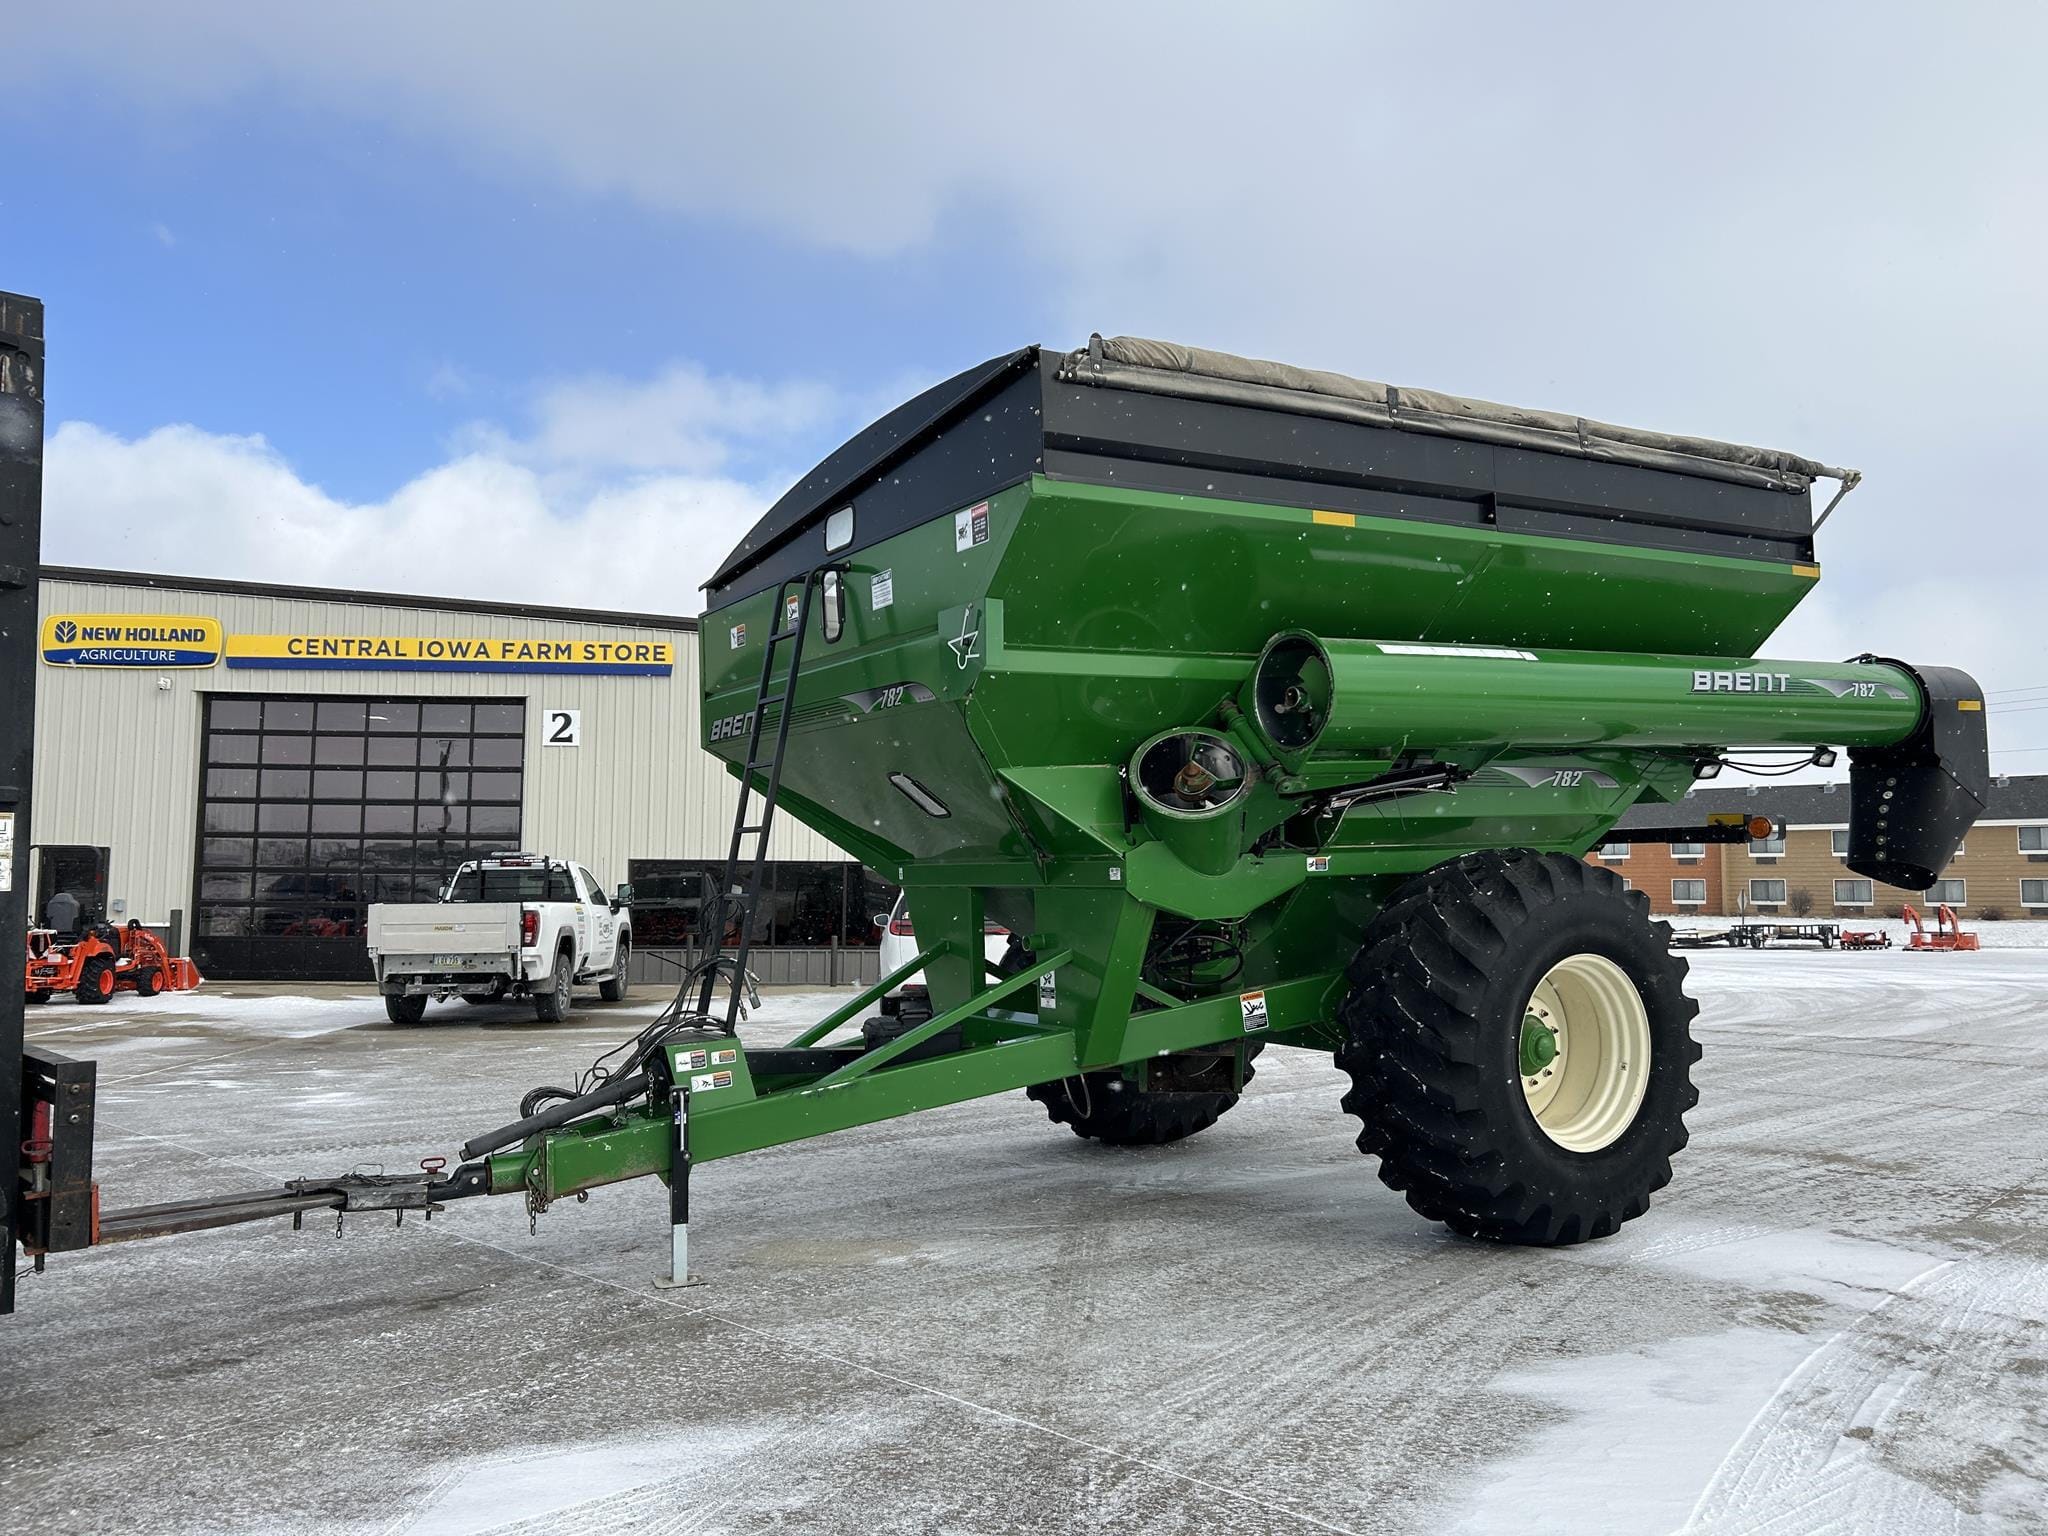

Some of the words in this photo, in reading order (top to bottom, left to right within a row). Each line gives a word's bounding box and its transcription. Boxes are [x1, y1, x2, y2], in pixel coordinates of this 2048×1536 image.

[81, 627, 121, 641] NEW
[125, 628, 206, 643] HOLLAND
[79, 649, 176, 661] AGRICULTURE
[287, 638, 407, 657] CENTRAL
[418, 640, 490, 659] IOWA
[502, 643, 572, 660] FARM
[583, 644, 666, 662] STORE
[1693, 670, 1790, 692] BRENT
[1851, 683, 1876, 698] 782
[880, 686, 904, 709] 782
[549, 712, 574, 743] 2
[710, 707, 768, 742] BREN
[1552, 771, 1582, 787] 782
